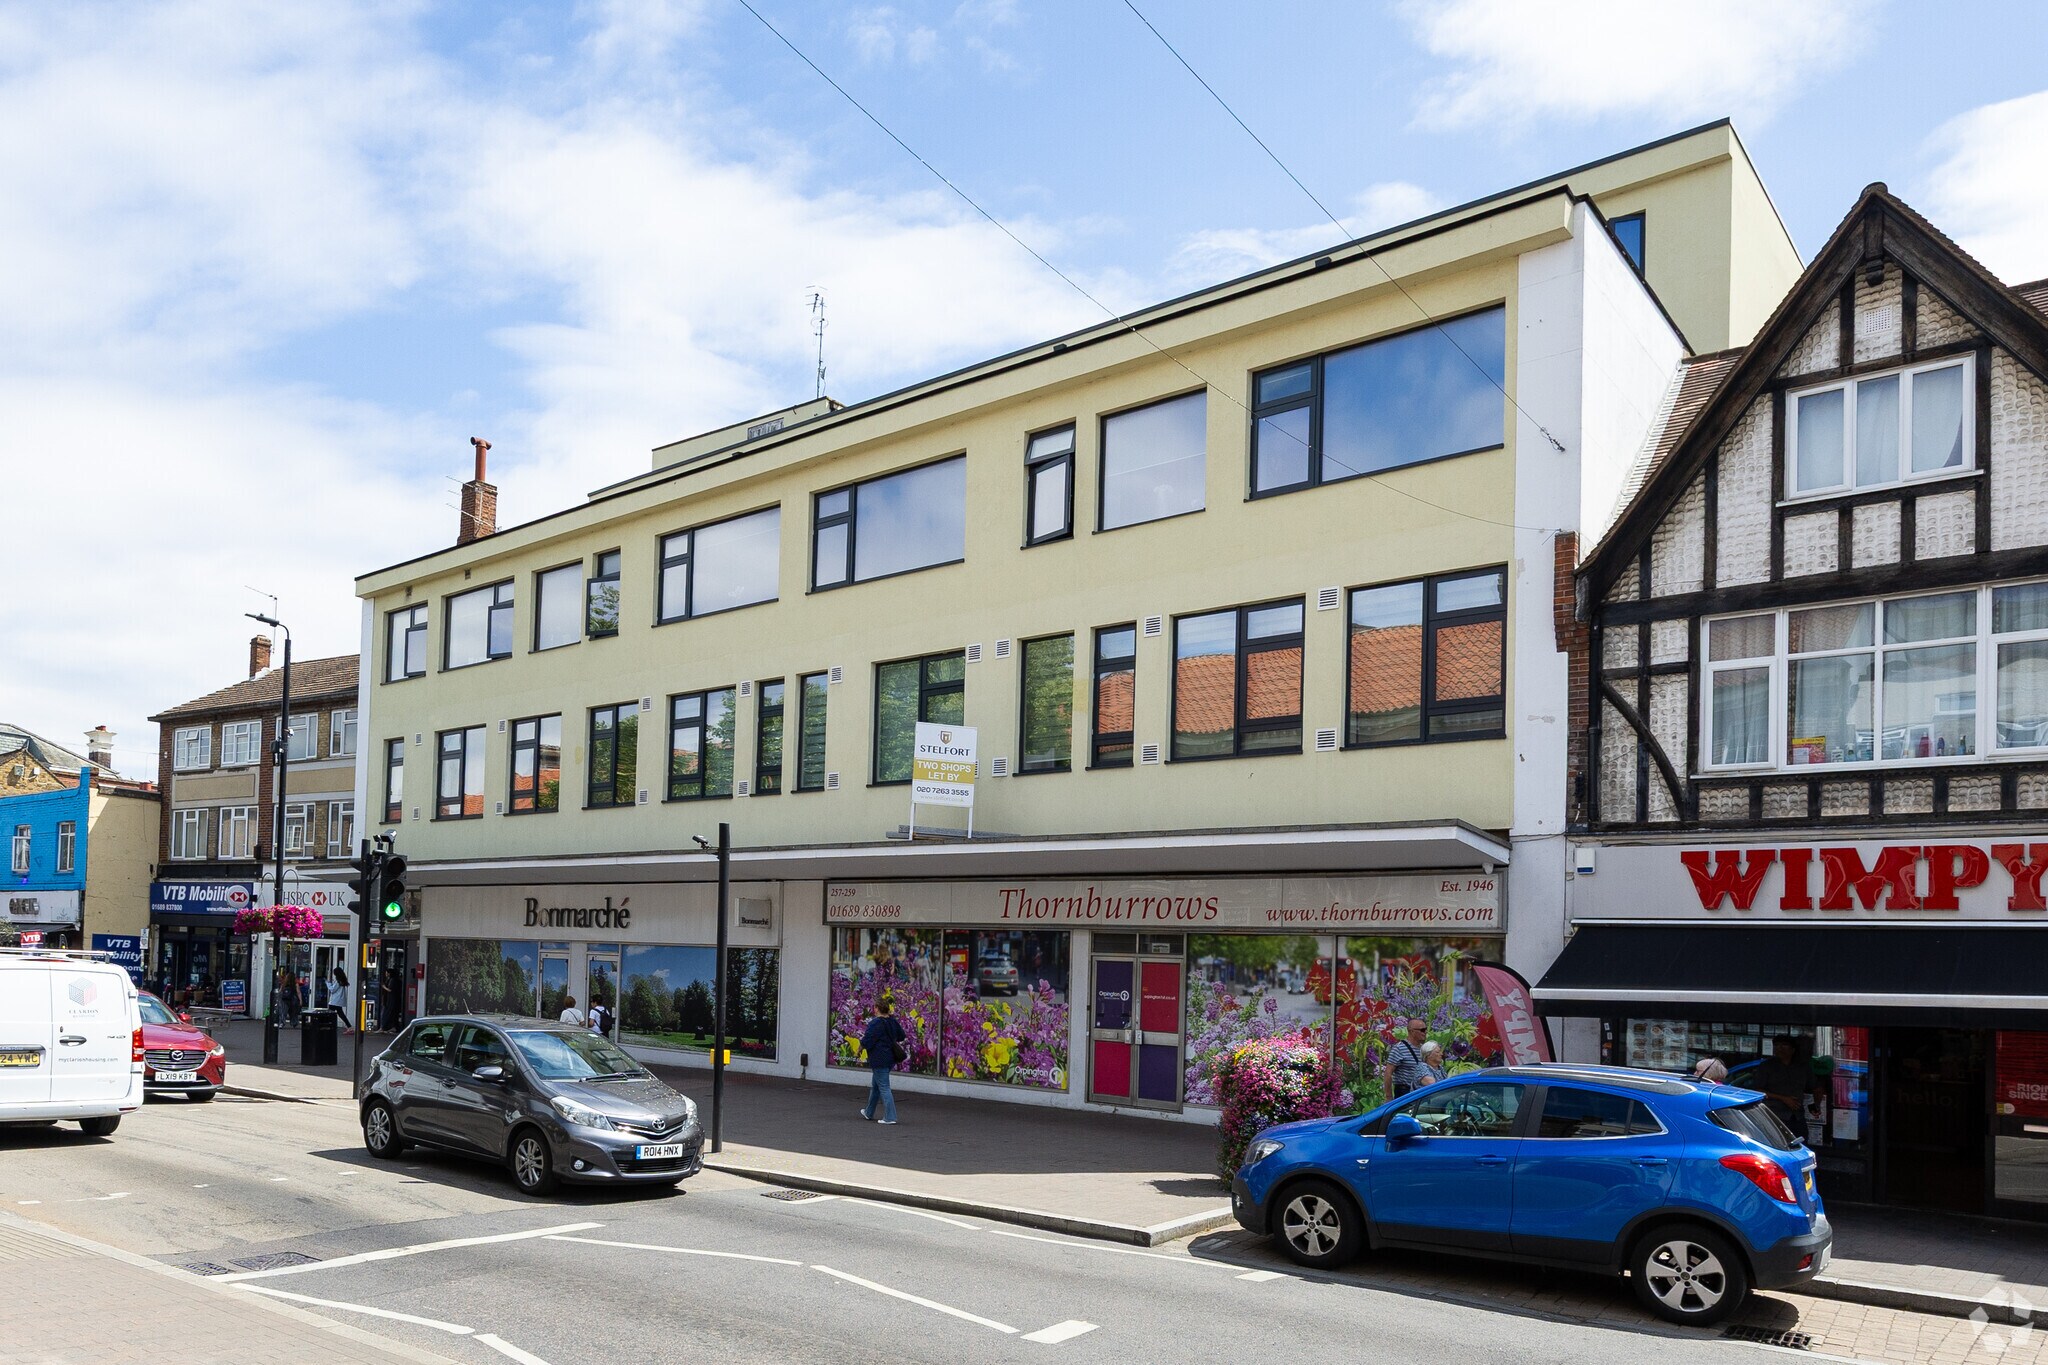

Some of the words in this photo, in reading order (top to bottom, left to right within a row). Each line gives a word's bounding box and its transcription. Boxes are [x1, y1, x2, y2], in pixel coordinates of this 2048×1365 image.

[920, 744, 970, 757] STELFORT
[917, 761, 938, 770] TWO
[940, 763, 972, 774] SHOPS
[928, 771, 945, 780] LET
[947, 773, 960, 782] BY
[916, 786, 931, 794] 020
[932, 787, 950, 795] 7263
[951, 789, 970, 797] 3555
[1681, 843, 2048, 911] WIMPY
[1441, 880, 1462, 892] Est.
[1466, 879, 1494, 892] 1946
[163, 885, 187, 900] VTB
[189, 885, 230, 901] Mobilit
[283, 891, 310, 906] HSBC
[328, 892, 345, 906] UK
[830, 888, 857, 897] 257-259
[999, 886, 1219, 920] Thornburrows
[523, 897, 631, 929] Bonmarché
[830, 905, 860, 917] 01689
[862, 905, 901, 917] 830898
[1266, 901, 1494, 922] www.thornburrows.com
[23, 934, 41, 942] VTB
[106, 939, 131, 948] VTB
[17, 1053, 38, 1063] YWC
[1015, 1066, 1049, 1079] Orpington
[2008, 1090, 2048, 1101] SINCE
[644, 1146, 662, 1157] RO14
[663, 1145, 679, 1156] HNX
